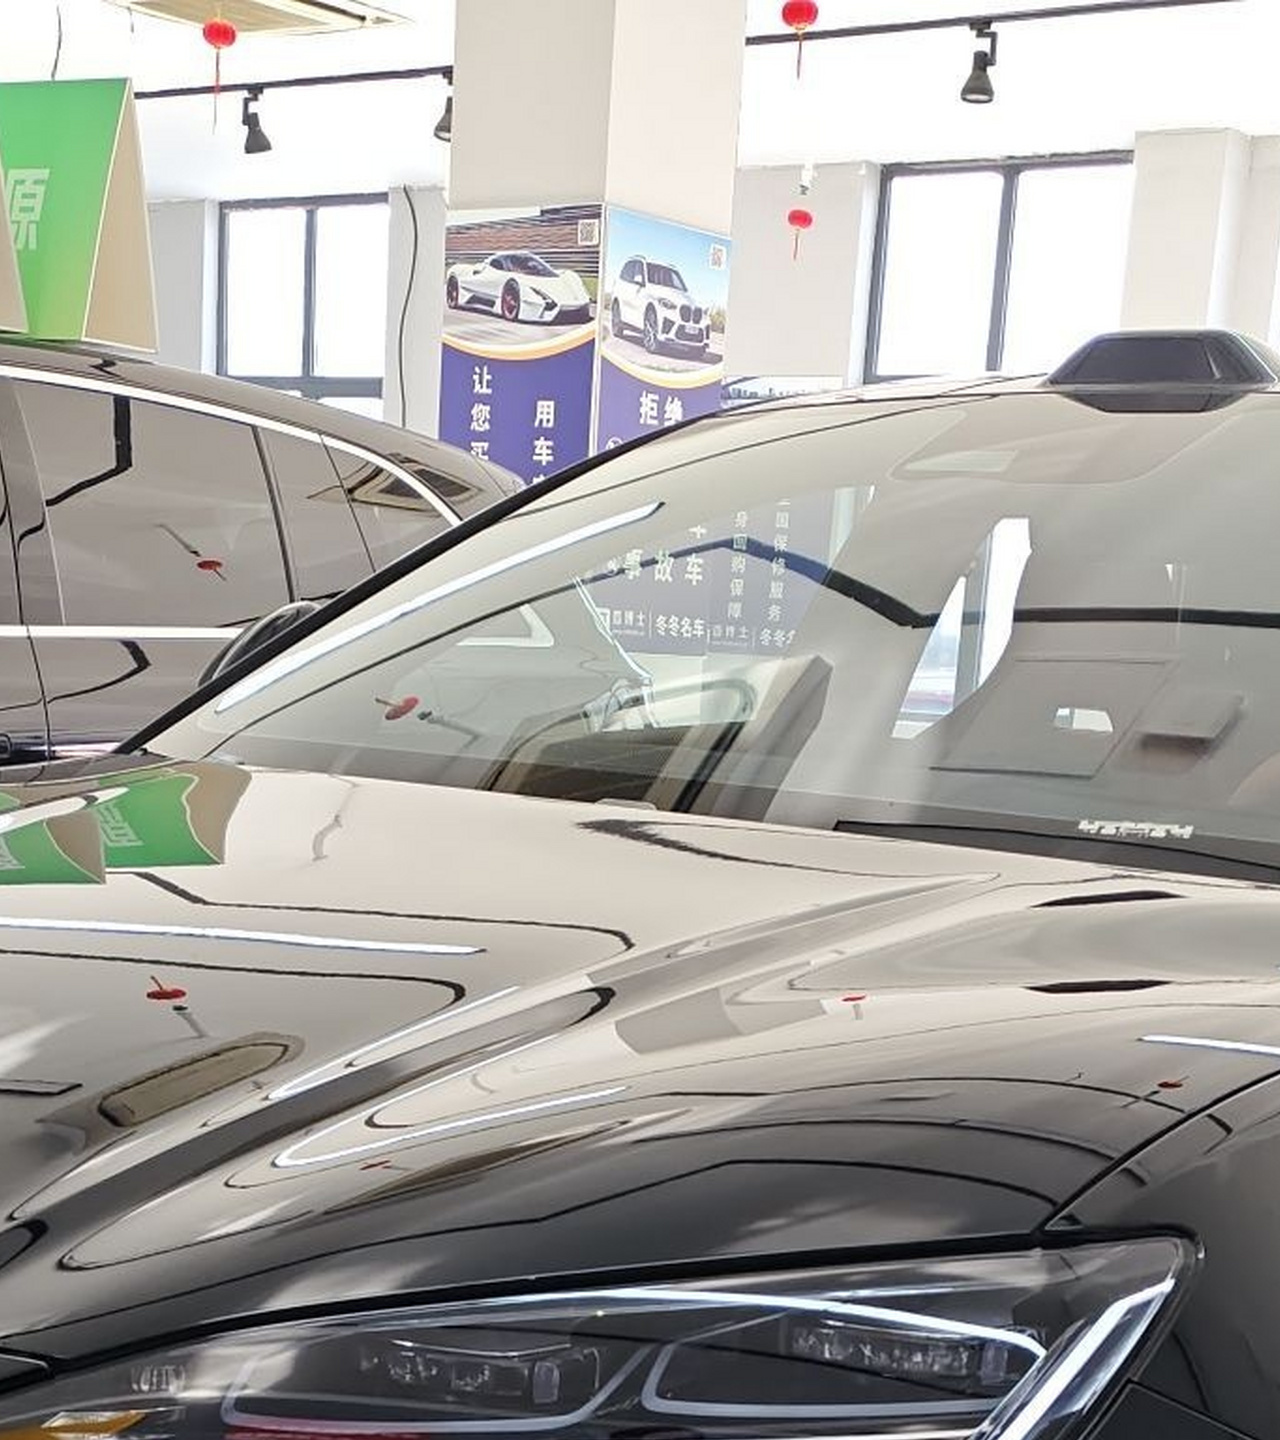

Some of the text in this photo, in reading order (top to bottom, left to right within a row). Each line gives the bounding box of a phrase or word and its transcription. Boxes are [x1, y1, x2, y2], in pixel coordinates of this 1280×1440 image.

[532, 400, 556, 485] 用车
[624, 549, 705, 585] 事故车
[768, 498, 791, 622] 国保修服务
[655, 614, 705, 638] 冬冬名车
